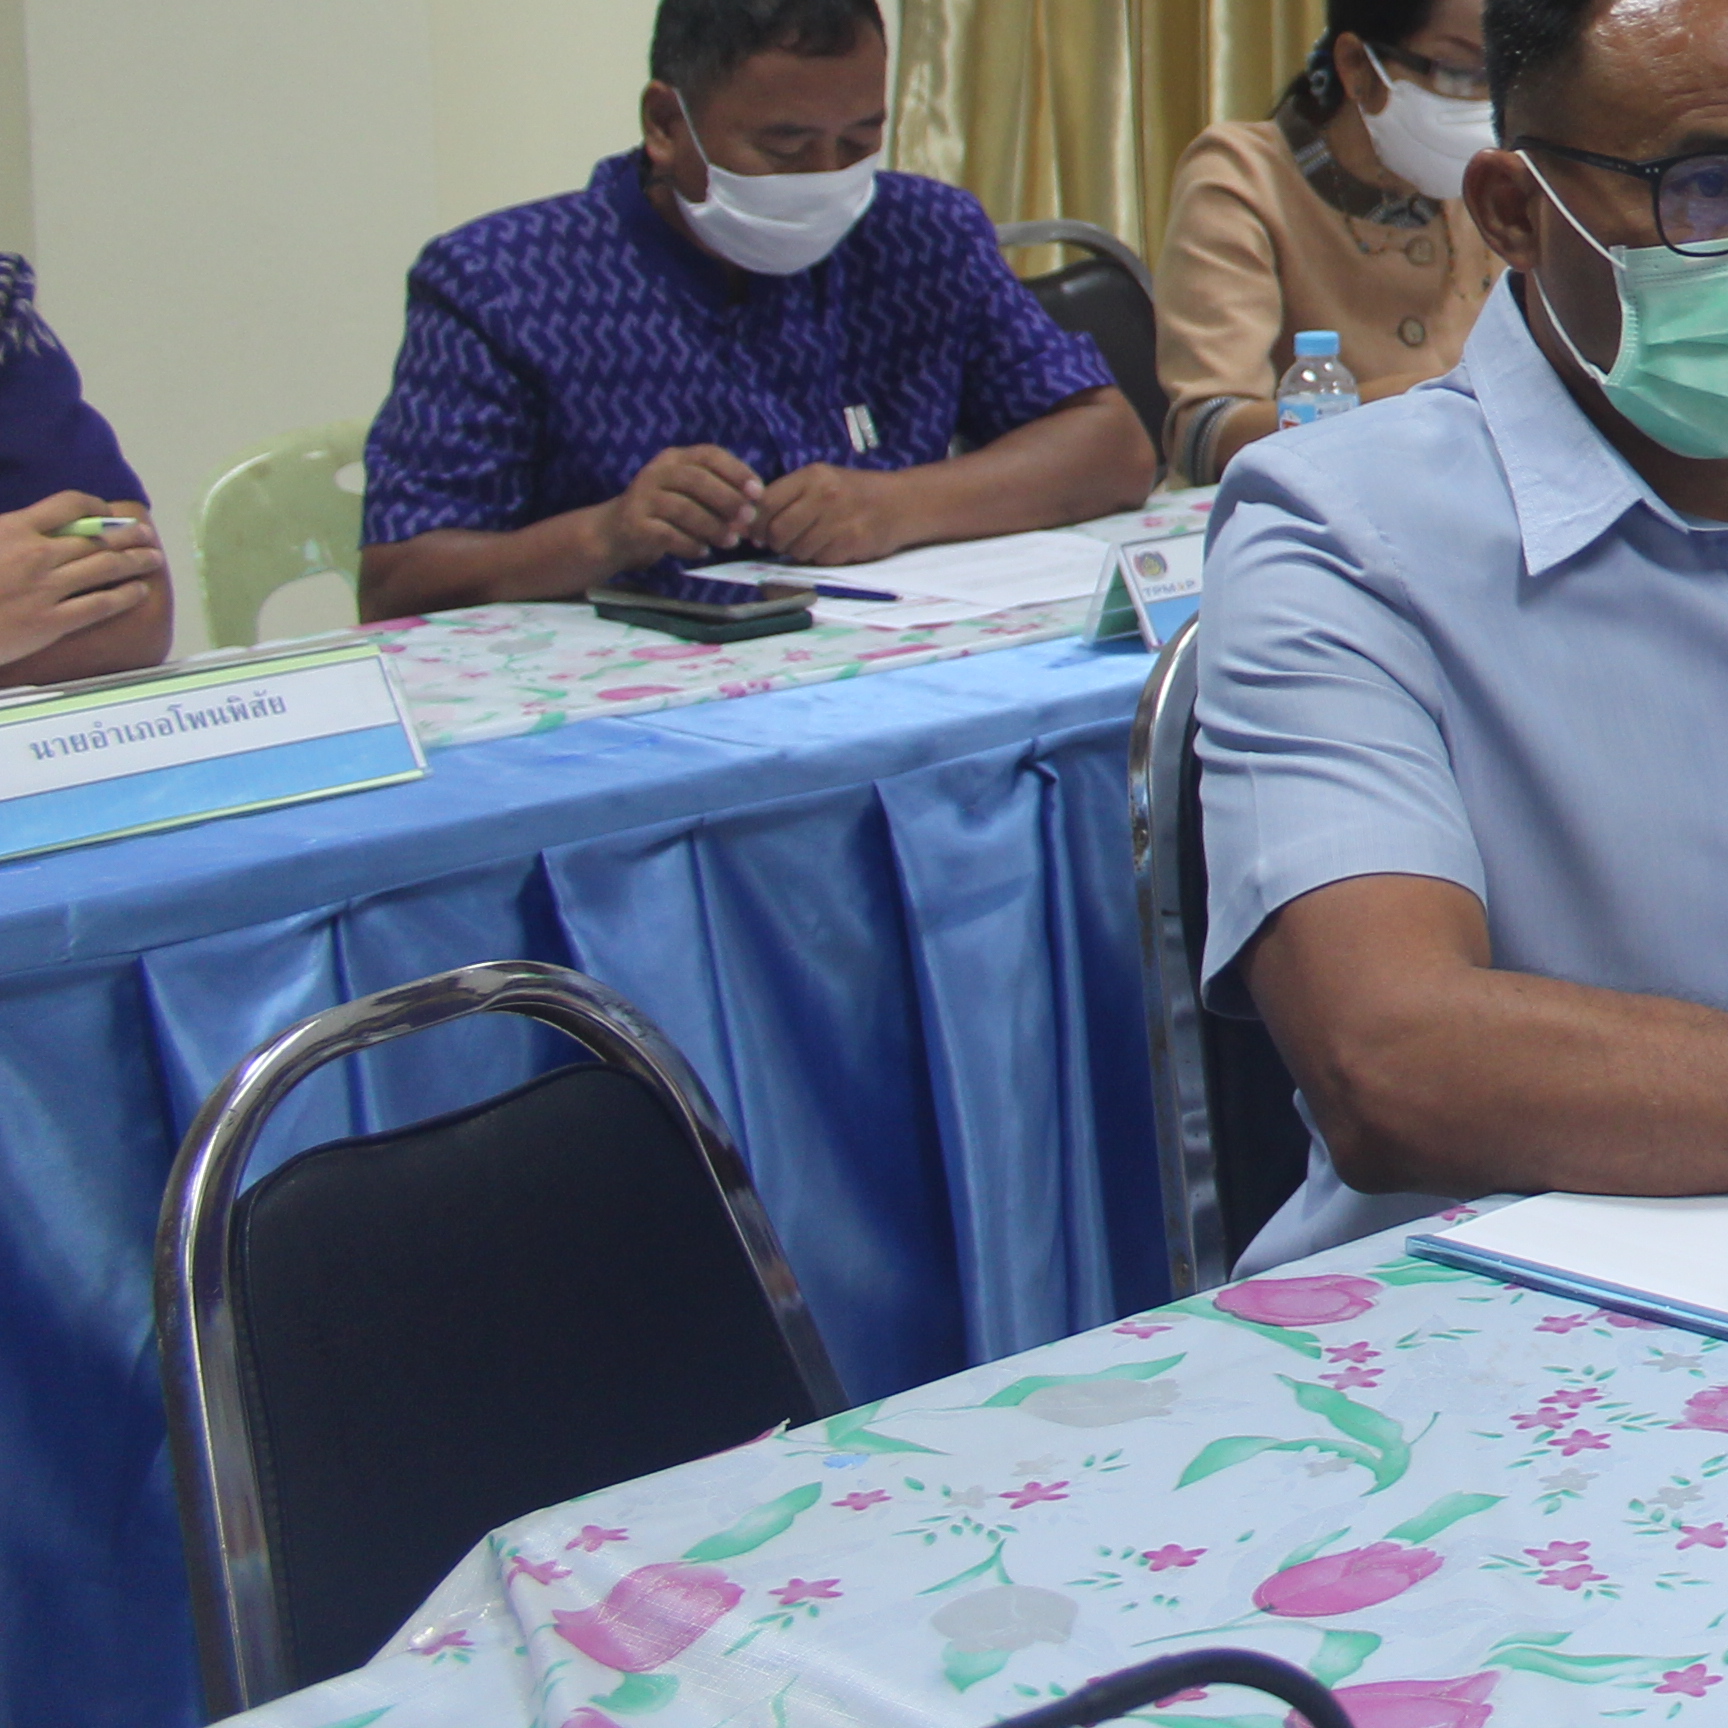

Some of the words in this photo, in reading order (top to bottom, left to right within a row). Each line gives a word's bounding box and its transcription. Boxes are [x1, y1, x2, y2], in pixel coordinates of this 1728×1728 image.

[30, 690, 287, 761] นายอำเภอโพนพิสัย
